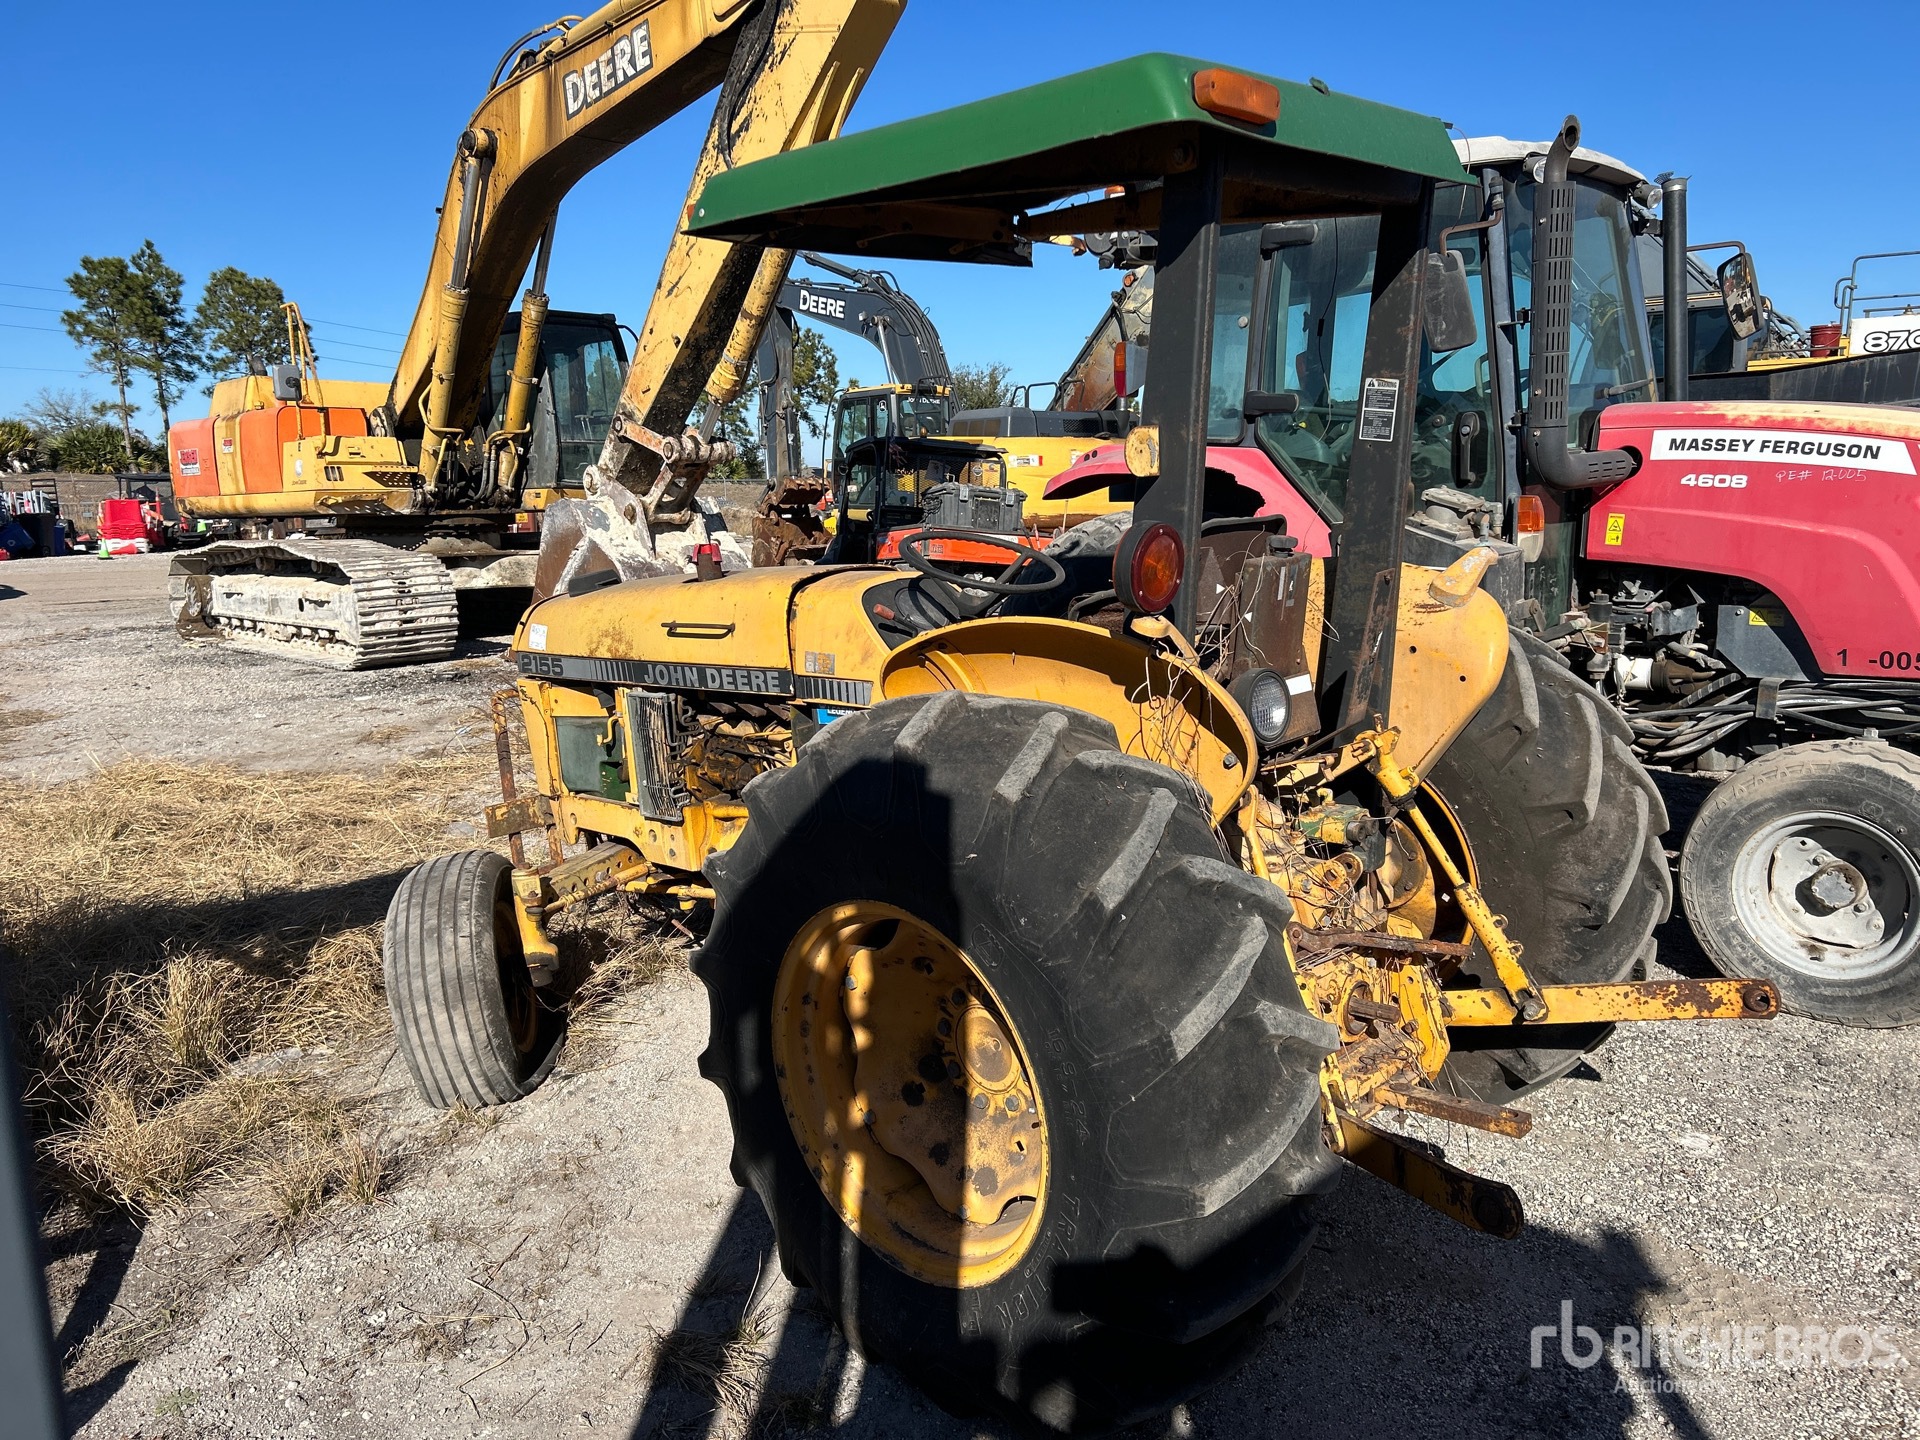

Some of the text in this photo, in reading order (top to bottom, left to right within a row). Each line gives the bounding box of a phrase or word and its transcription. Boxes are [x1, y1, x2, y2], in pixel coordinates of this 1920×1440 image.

[564, 22, 652, 117] DEERE
[800, 289, 845, 319] DEERE
[1668, 438, 1881, 459] MASSEY FERGUSON
[1680, 473, 1748, 488] 4608
[1822, 469, 1867, 481] 12-005
[520, 653, 781, 693] 2155 JOHN DEERE
